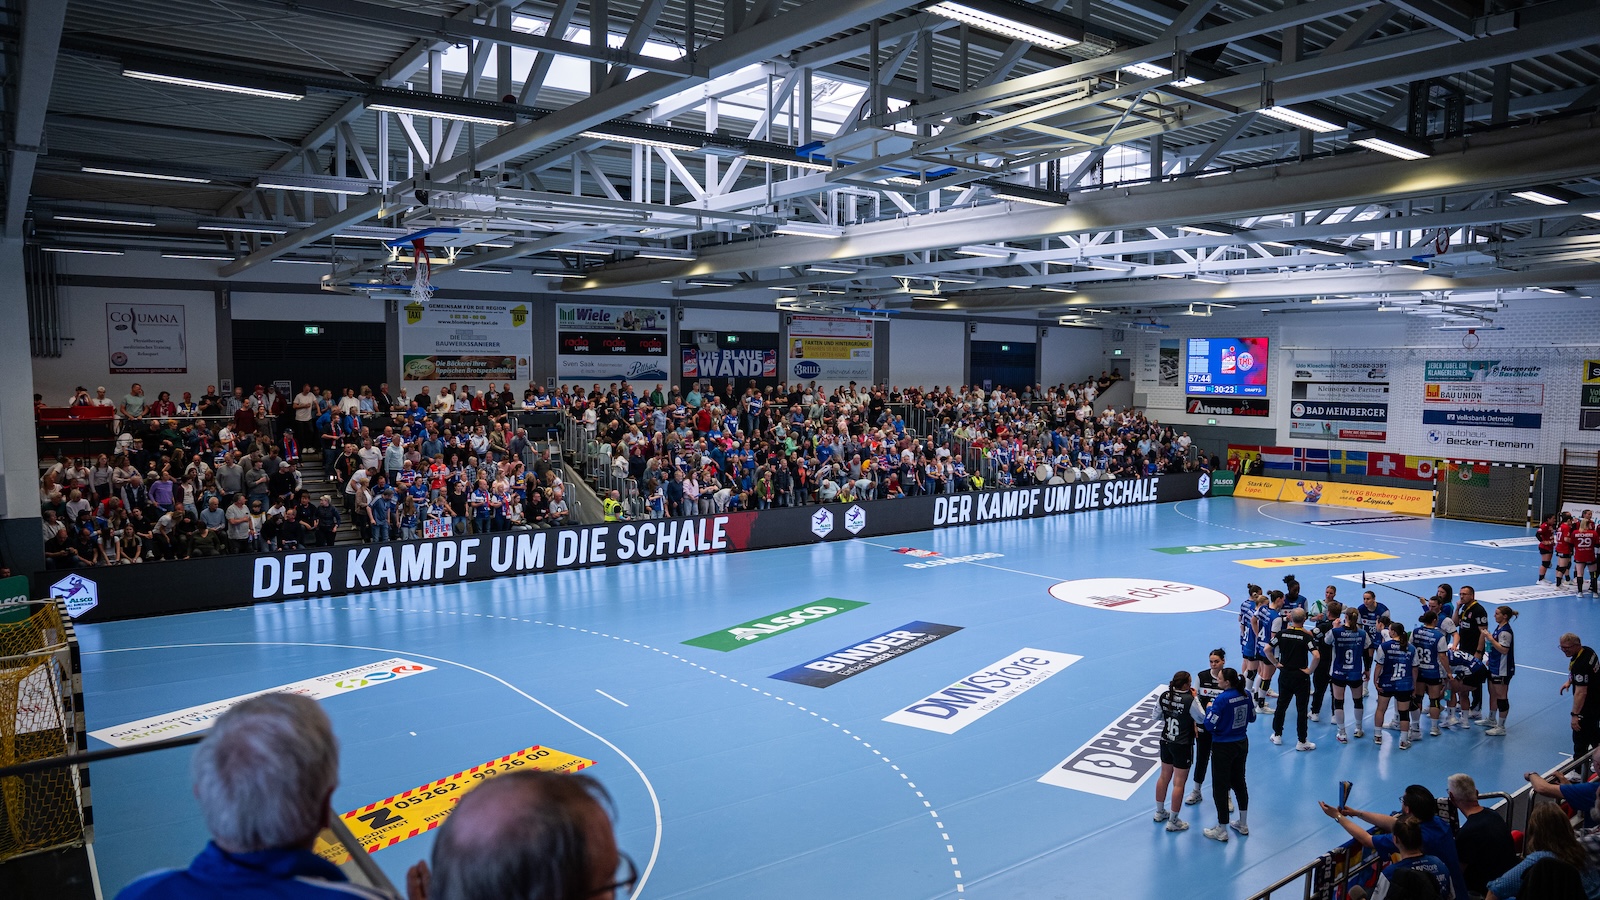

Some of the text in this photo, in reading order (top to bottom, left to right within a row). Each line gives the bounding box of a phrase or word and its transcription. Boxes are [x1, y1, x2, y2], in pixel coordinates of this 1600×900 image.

[408, 311, 421, 319] TAXI
[513, 314, 525, 322] TAXI
[576, 308, 611, 322] Wiele
[678, 311, 683, 320] C
[787, 316, 792, 325] D
[970, 325, 976, 333] E
[1042, 329, 1047, 337] F
[564, 336, 589, 347] radio
[602, 336, 626, 347] radio
[639, 337, 662, 347] radio
[699, 350, 763, 360] DIE BLAUE
[698, 359, 763, 376] WAND
[1188, 374, 1211, 383] 57:44
[1193, 400, 1233, 414] Ahrens
[1306, 406, 1386, 417] BAD MEINBERGER
[1456, 414, 1487, 422] Volksbank
[1446, 430, 1487, 438] autohaus
[1446, 437, 1534, 449] Becker-Tiemann
[933, 477, 1159, 525] DER KAMPF UM DIE SCHALE
[1363, 497, 1394, 506] Lippische
[1365, 490, 1421, 502] Blomberg-Lippe
[1186, 541, 1279, 553] ALSCO
[1577, 537, 1592, 548] 29
[252, 516, 729, 599] DER KAMPF UM DIE SCHALE
[1290, 552, 1363, 563] Lippische
[1128, 581, 1196, 600] dhs
[728, 605, 838, 641] ALSCO
[804, 629, 926, 674] BINDER
[1344, 649, 1354, 665] 9
[316, 659, 401, 682] BLOMBERGER
[1392, 663, 1407, 678] 15
[977, 669, 1055, 712] YOUR LINK TO BEAUTY
[110, 704, 227, 738] Gut versorgt aus
[1166, 716, 1180, 737] 16
[120, 723, 180, 742] Strom
[394, 782, 461, 810] 05262
[472, 767, 498, 780] 99
[500, 757, 526, 771] 26
[526, 749, 551, 761] 00
